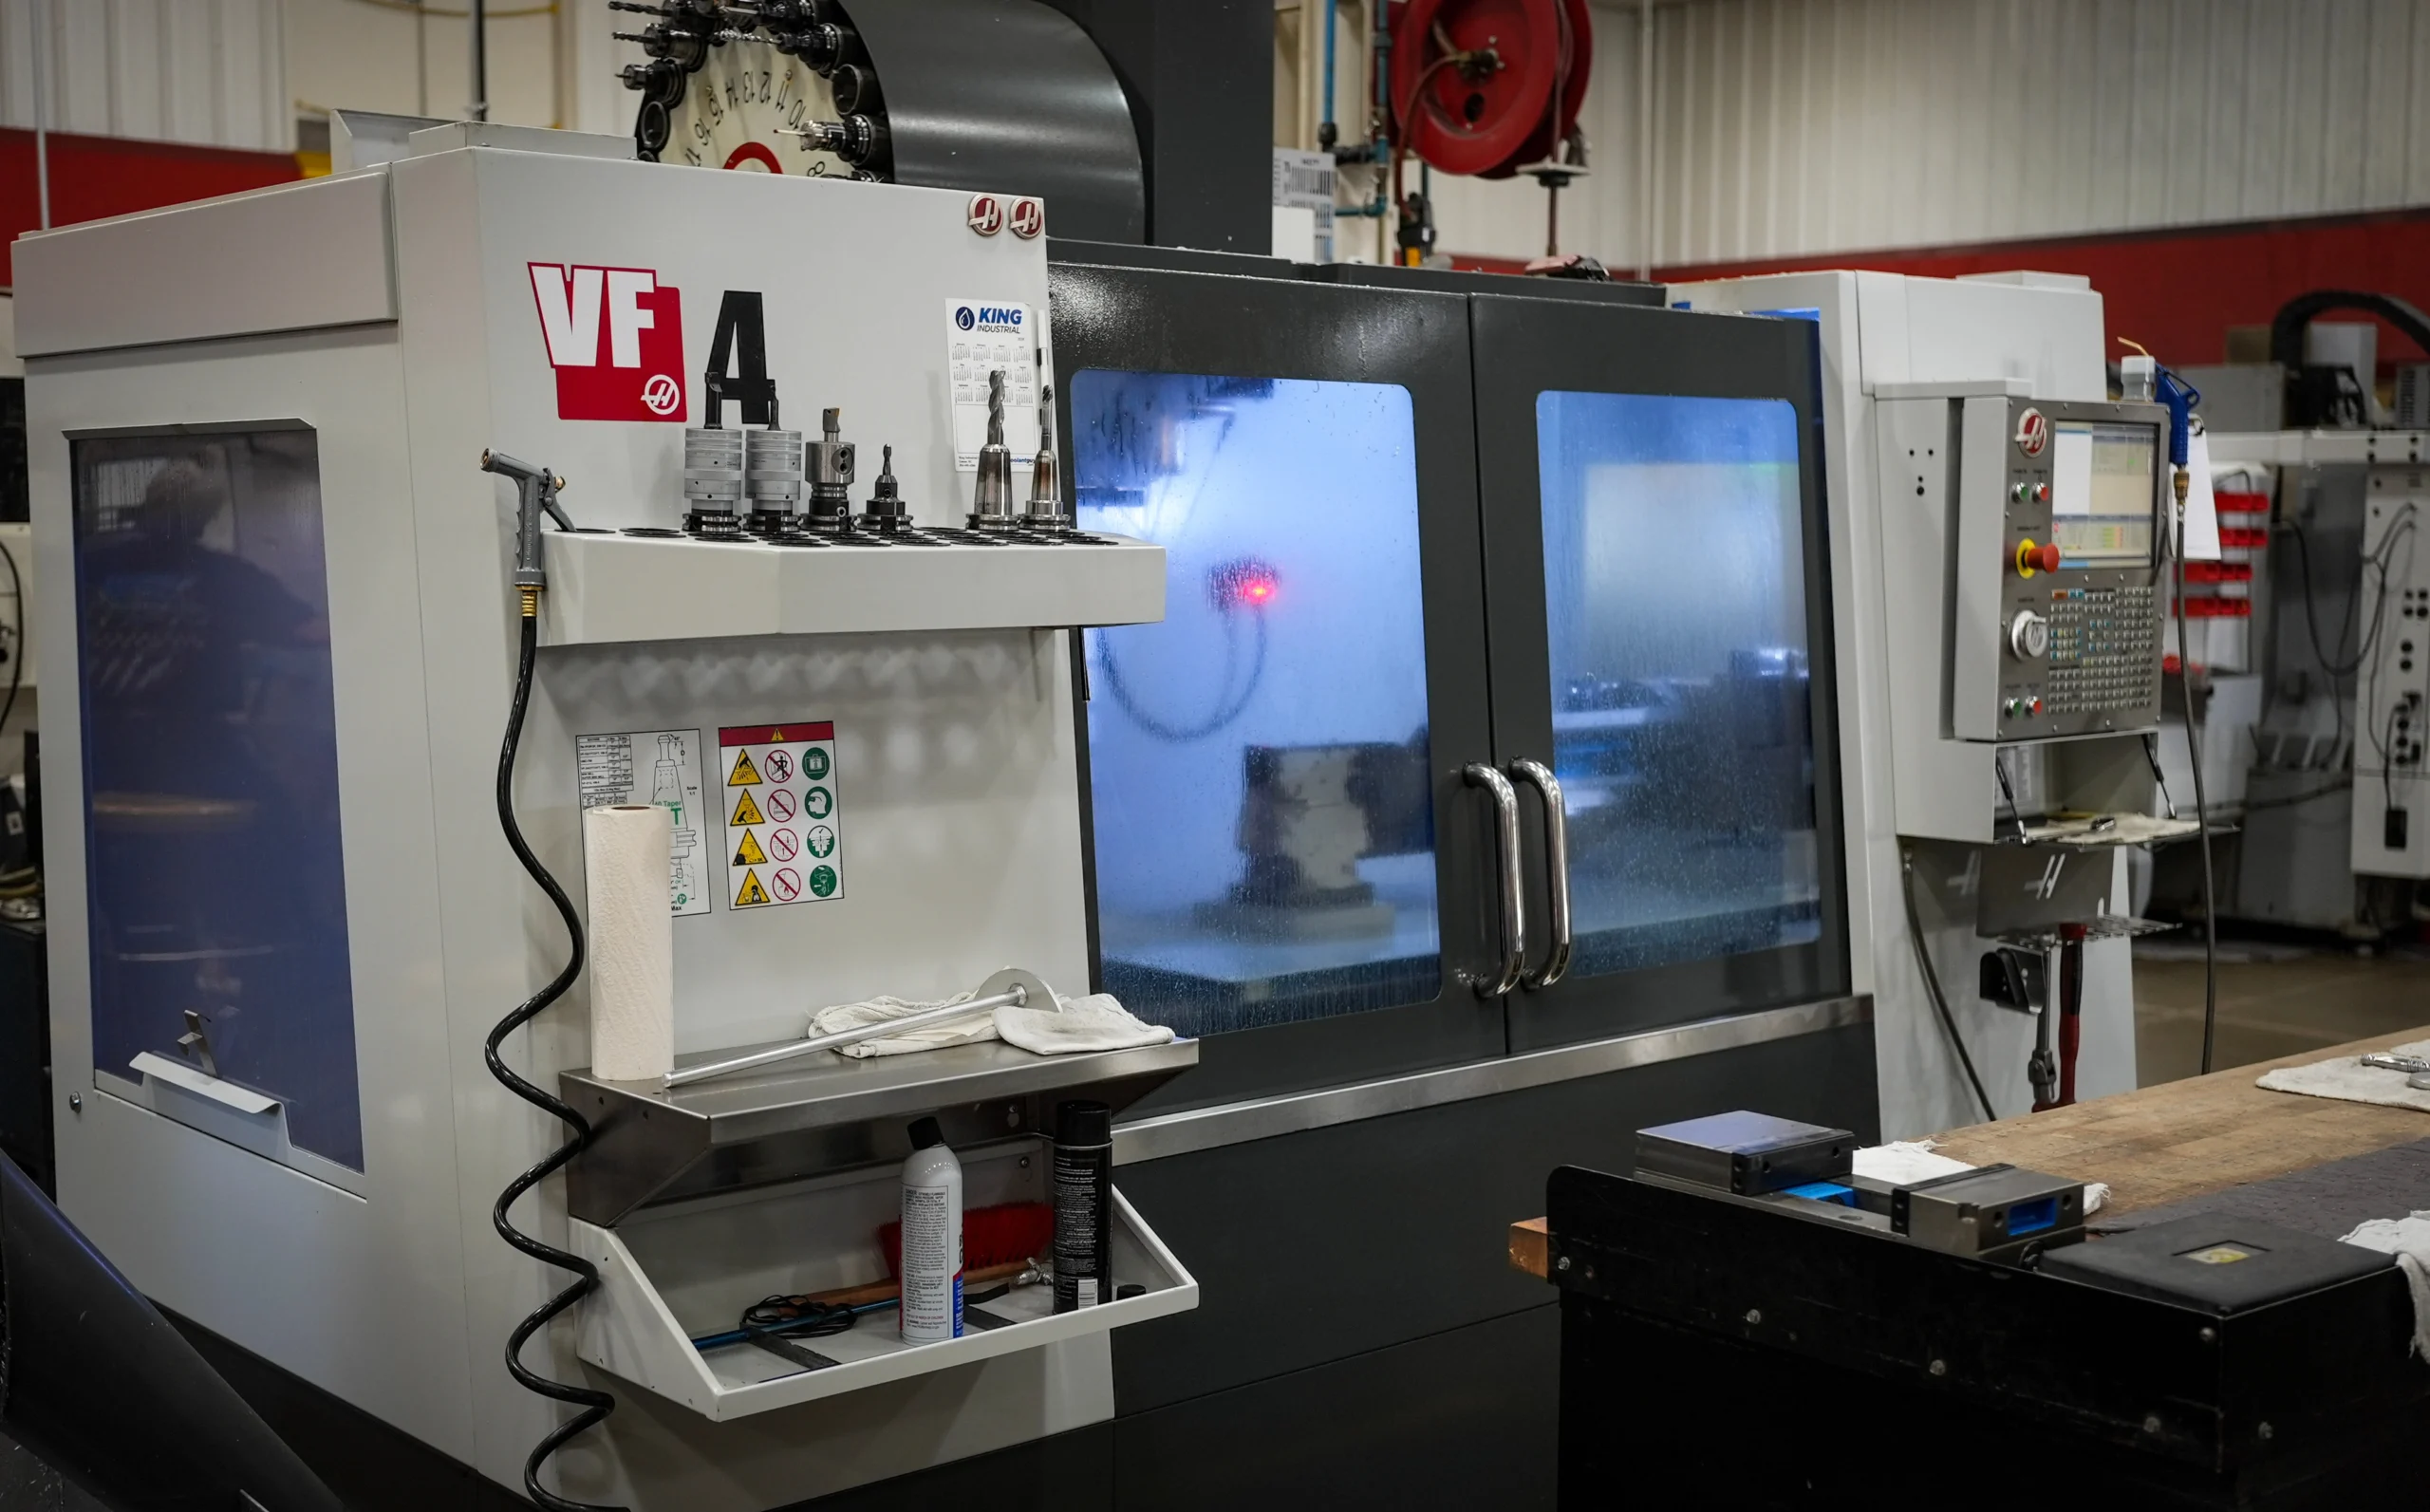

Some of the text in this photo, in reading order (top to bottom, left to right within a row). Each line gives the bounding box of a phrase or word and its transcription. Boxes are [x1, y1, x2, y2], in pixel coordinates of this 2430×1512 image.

[725, 78, 738, 110] 14
[742, 71, 755, 103] 13
[758, 71, 772, 104] 12
[788, 99, 806, 129] 10
[695, 118, 711, 145] 16
[530, 264, 655, 368] VF
[977, 324, 1020, 334] INDUSTRIAL
[979, 308, 1022, 325] KING
